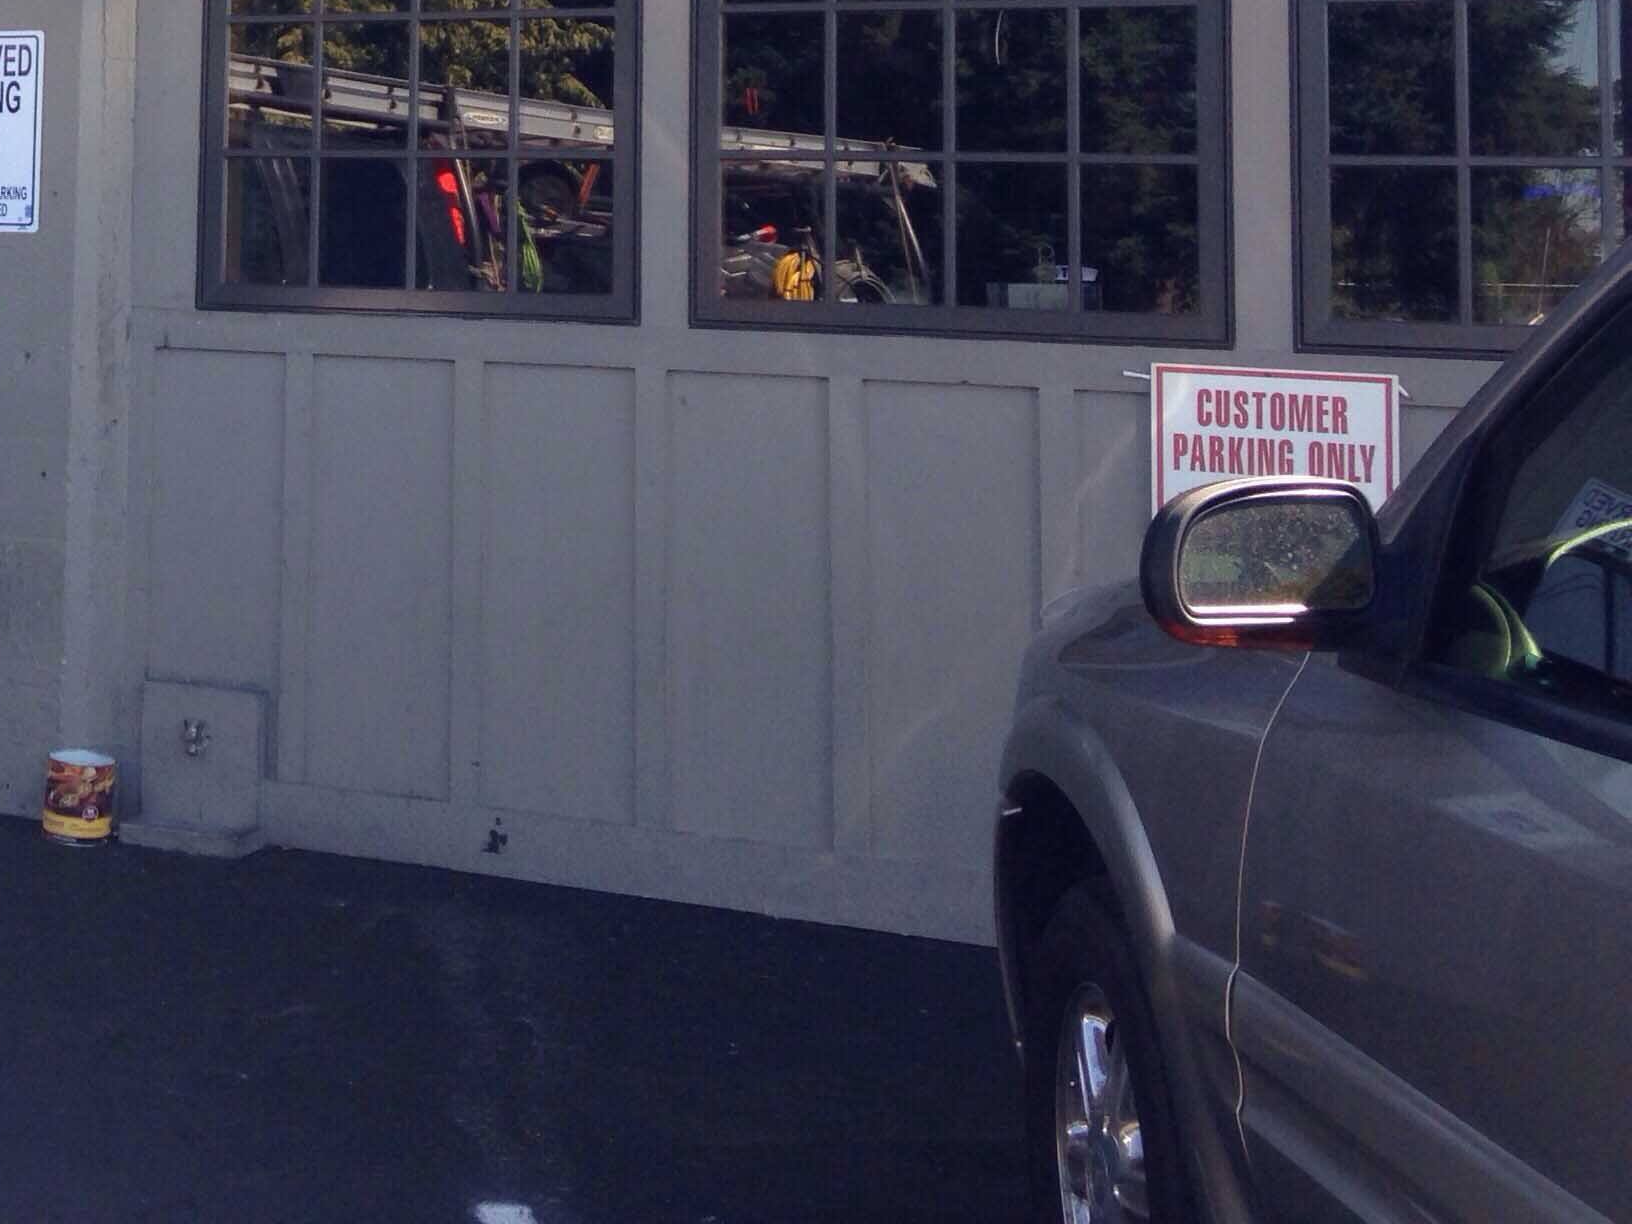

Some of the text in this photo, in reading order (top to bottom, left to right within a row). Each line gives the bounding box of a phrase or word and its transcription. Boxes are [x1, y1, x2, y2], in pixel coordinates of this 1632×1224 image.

[1196, 388, 1349, 434] CUSTOMER
[1172, 432, 1376, 484] PARKING ONLY
